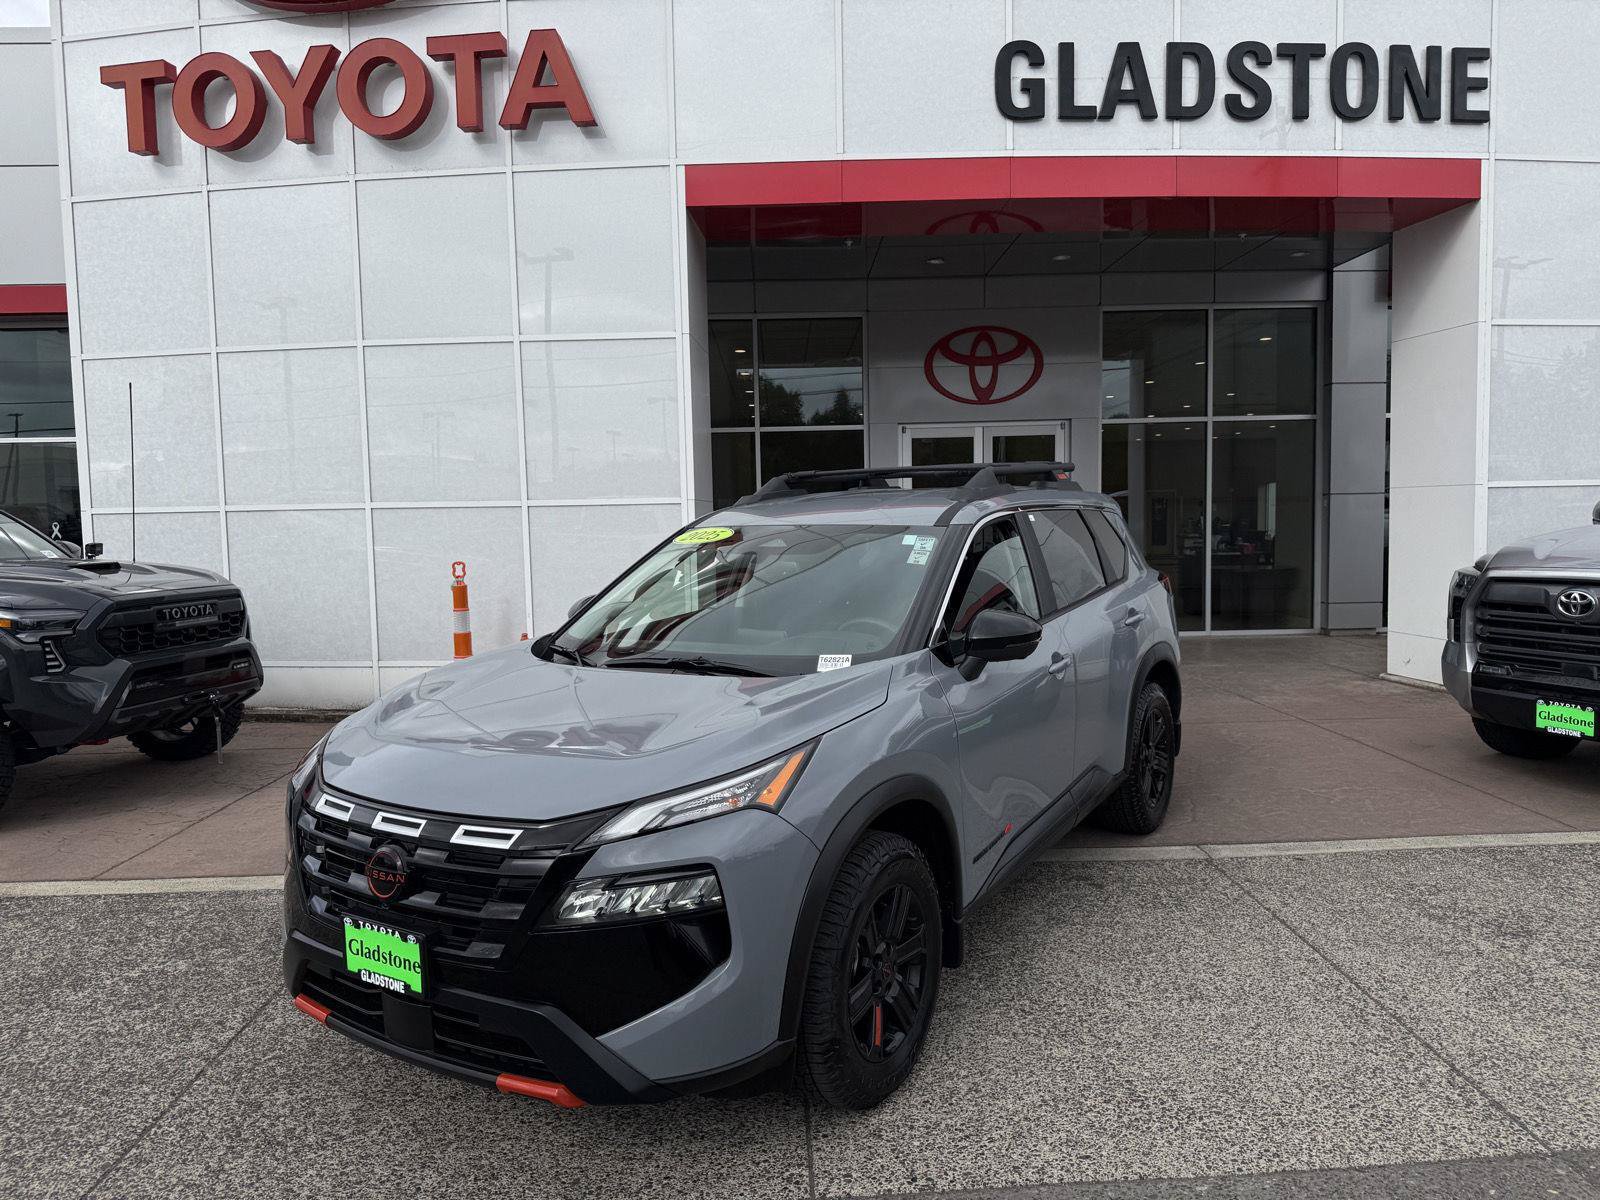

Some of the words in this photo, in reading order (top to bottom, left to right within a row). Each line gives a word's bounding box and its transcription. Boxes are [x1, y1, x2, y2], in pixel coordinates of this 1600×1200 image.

[994, 40, 1491, 124] GLADSTONE
[100, 28, 597, 156] TOYOTA
[163, 604, 214, 620] TOYOTA
[1549, 701, 1581, 709] TOYOTA
[1538, 710, 1594, 728] Gladstone
[1547, 727, 1581, 737] GLADSTONE
[358, 920, 401, 939] TOYOTA
[348, 938, 421, 974] Gladstone
[361, 969, 405, 993] GLADSTONE
